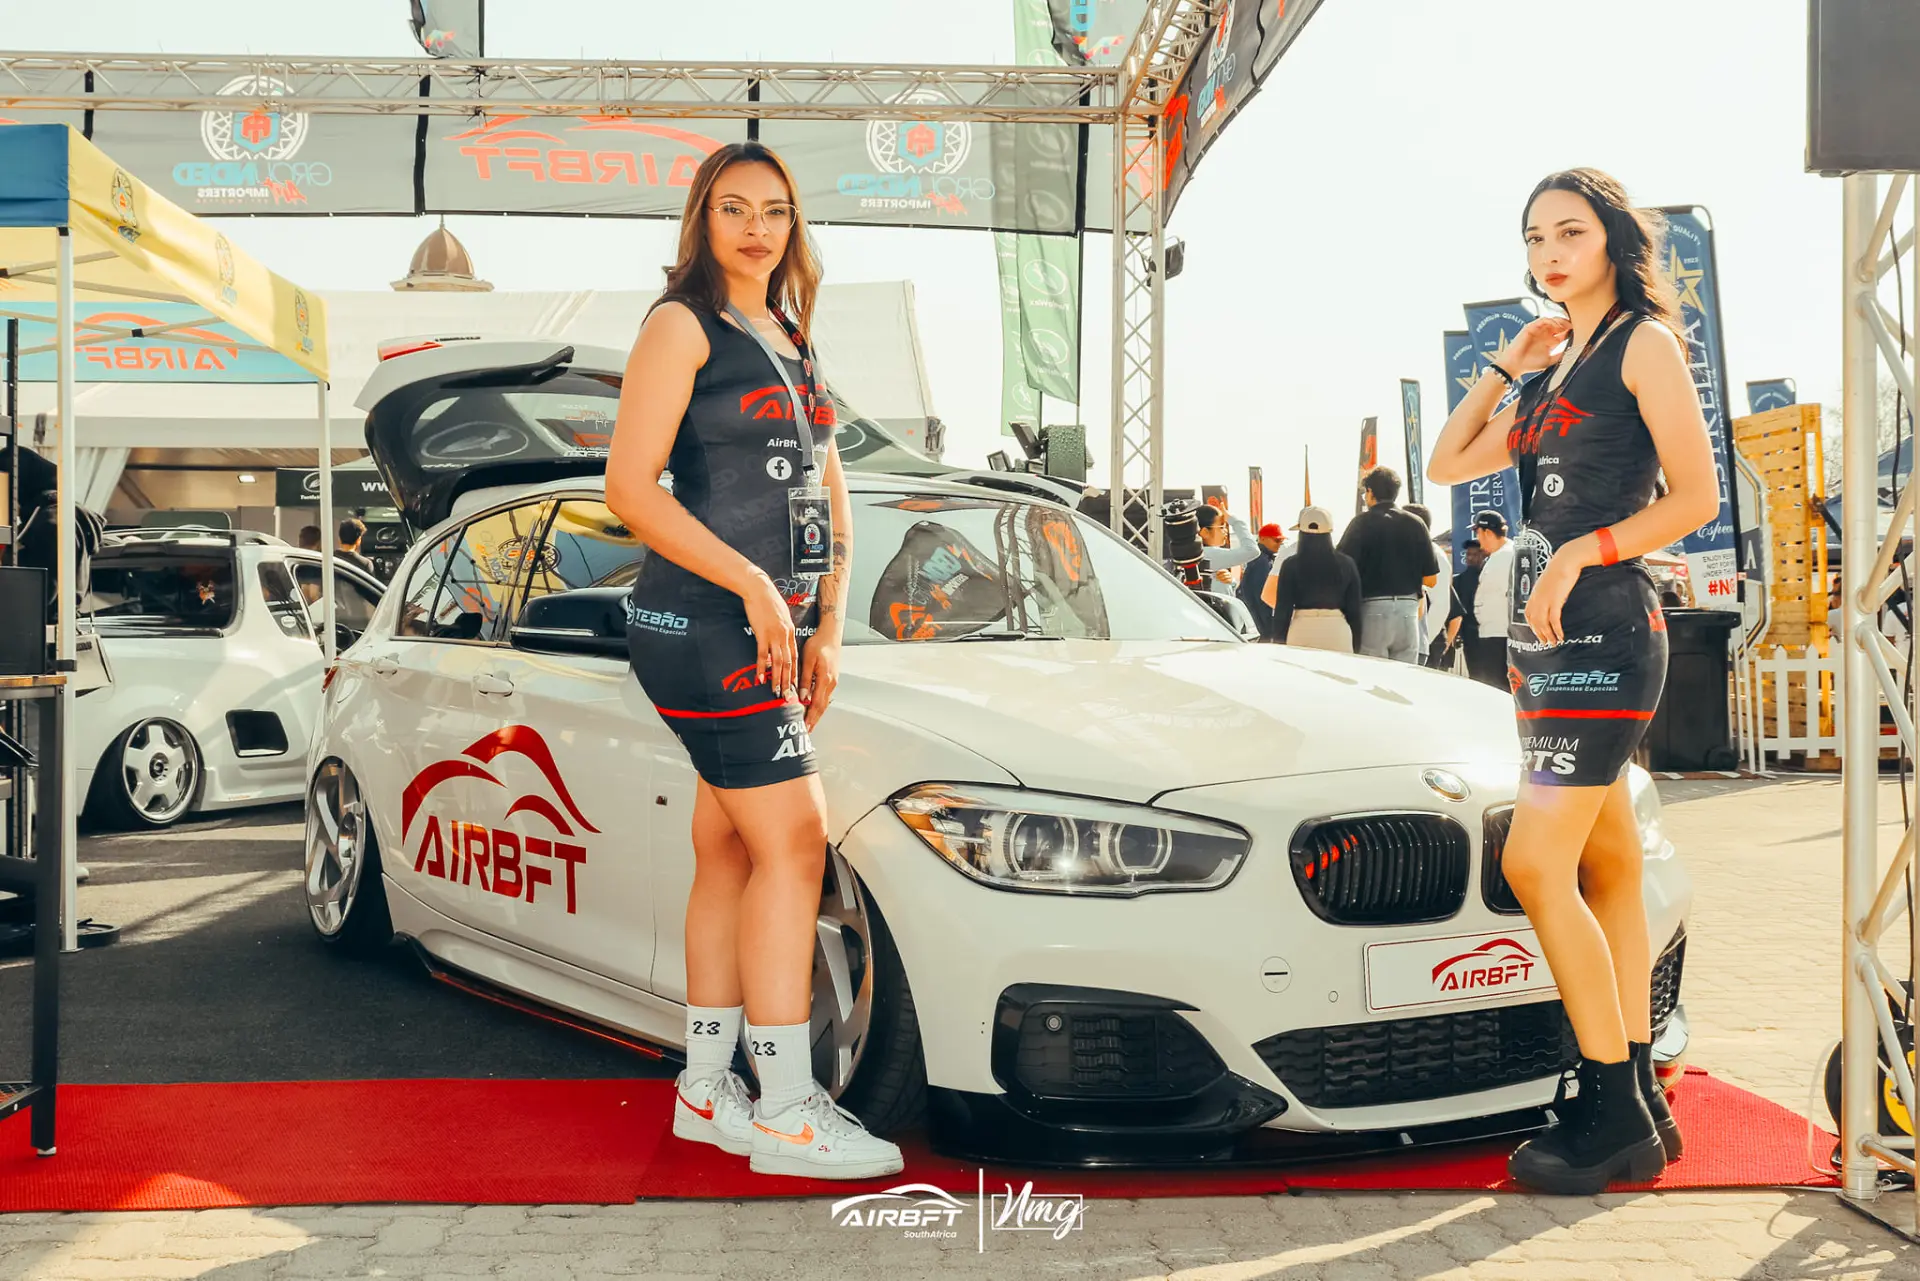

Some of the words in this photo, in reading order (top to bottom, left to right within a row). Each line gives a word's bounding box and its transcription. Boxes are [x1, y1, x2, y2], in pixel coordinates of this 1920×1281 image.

[1502, 312, 1526, 325] QUALIT
[361, 481, 389, 492] ww
[413, 815, 587, 914] AIRBFT
[1440, 962, 1535, 992] AIRBFT
[693, 1020, 721, 1035] 23
[752, 1040, 777, 1056] 23
